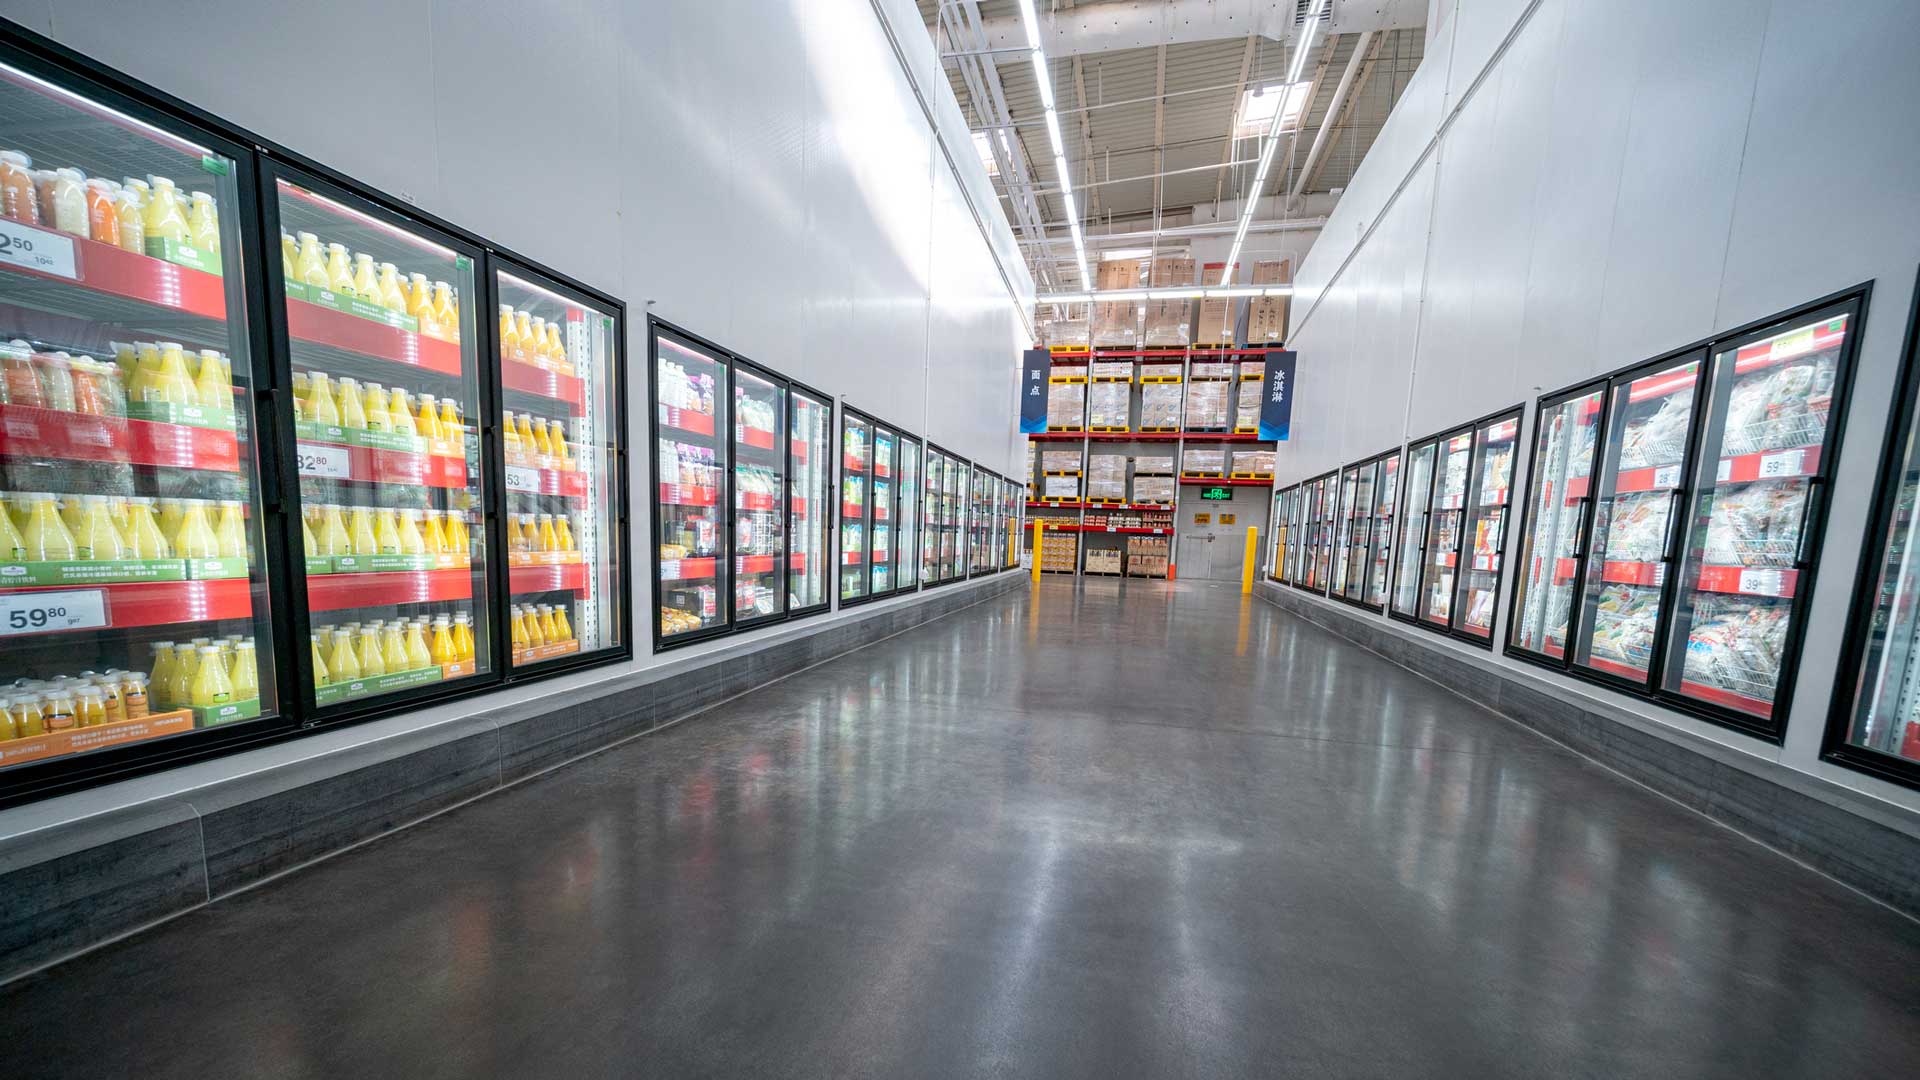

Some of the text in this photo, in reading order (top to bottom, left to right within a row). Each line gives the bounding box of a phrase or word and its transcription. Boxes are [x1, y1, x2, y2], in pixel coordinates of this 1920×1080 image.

[1030, 369, 1041, 396] 面点
[1272, 369, 1285, 403] 冰淇淋
